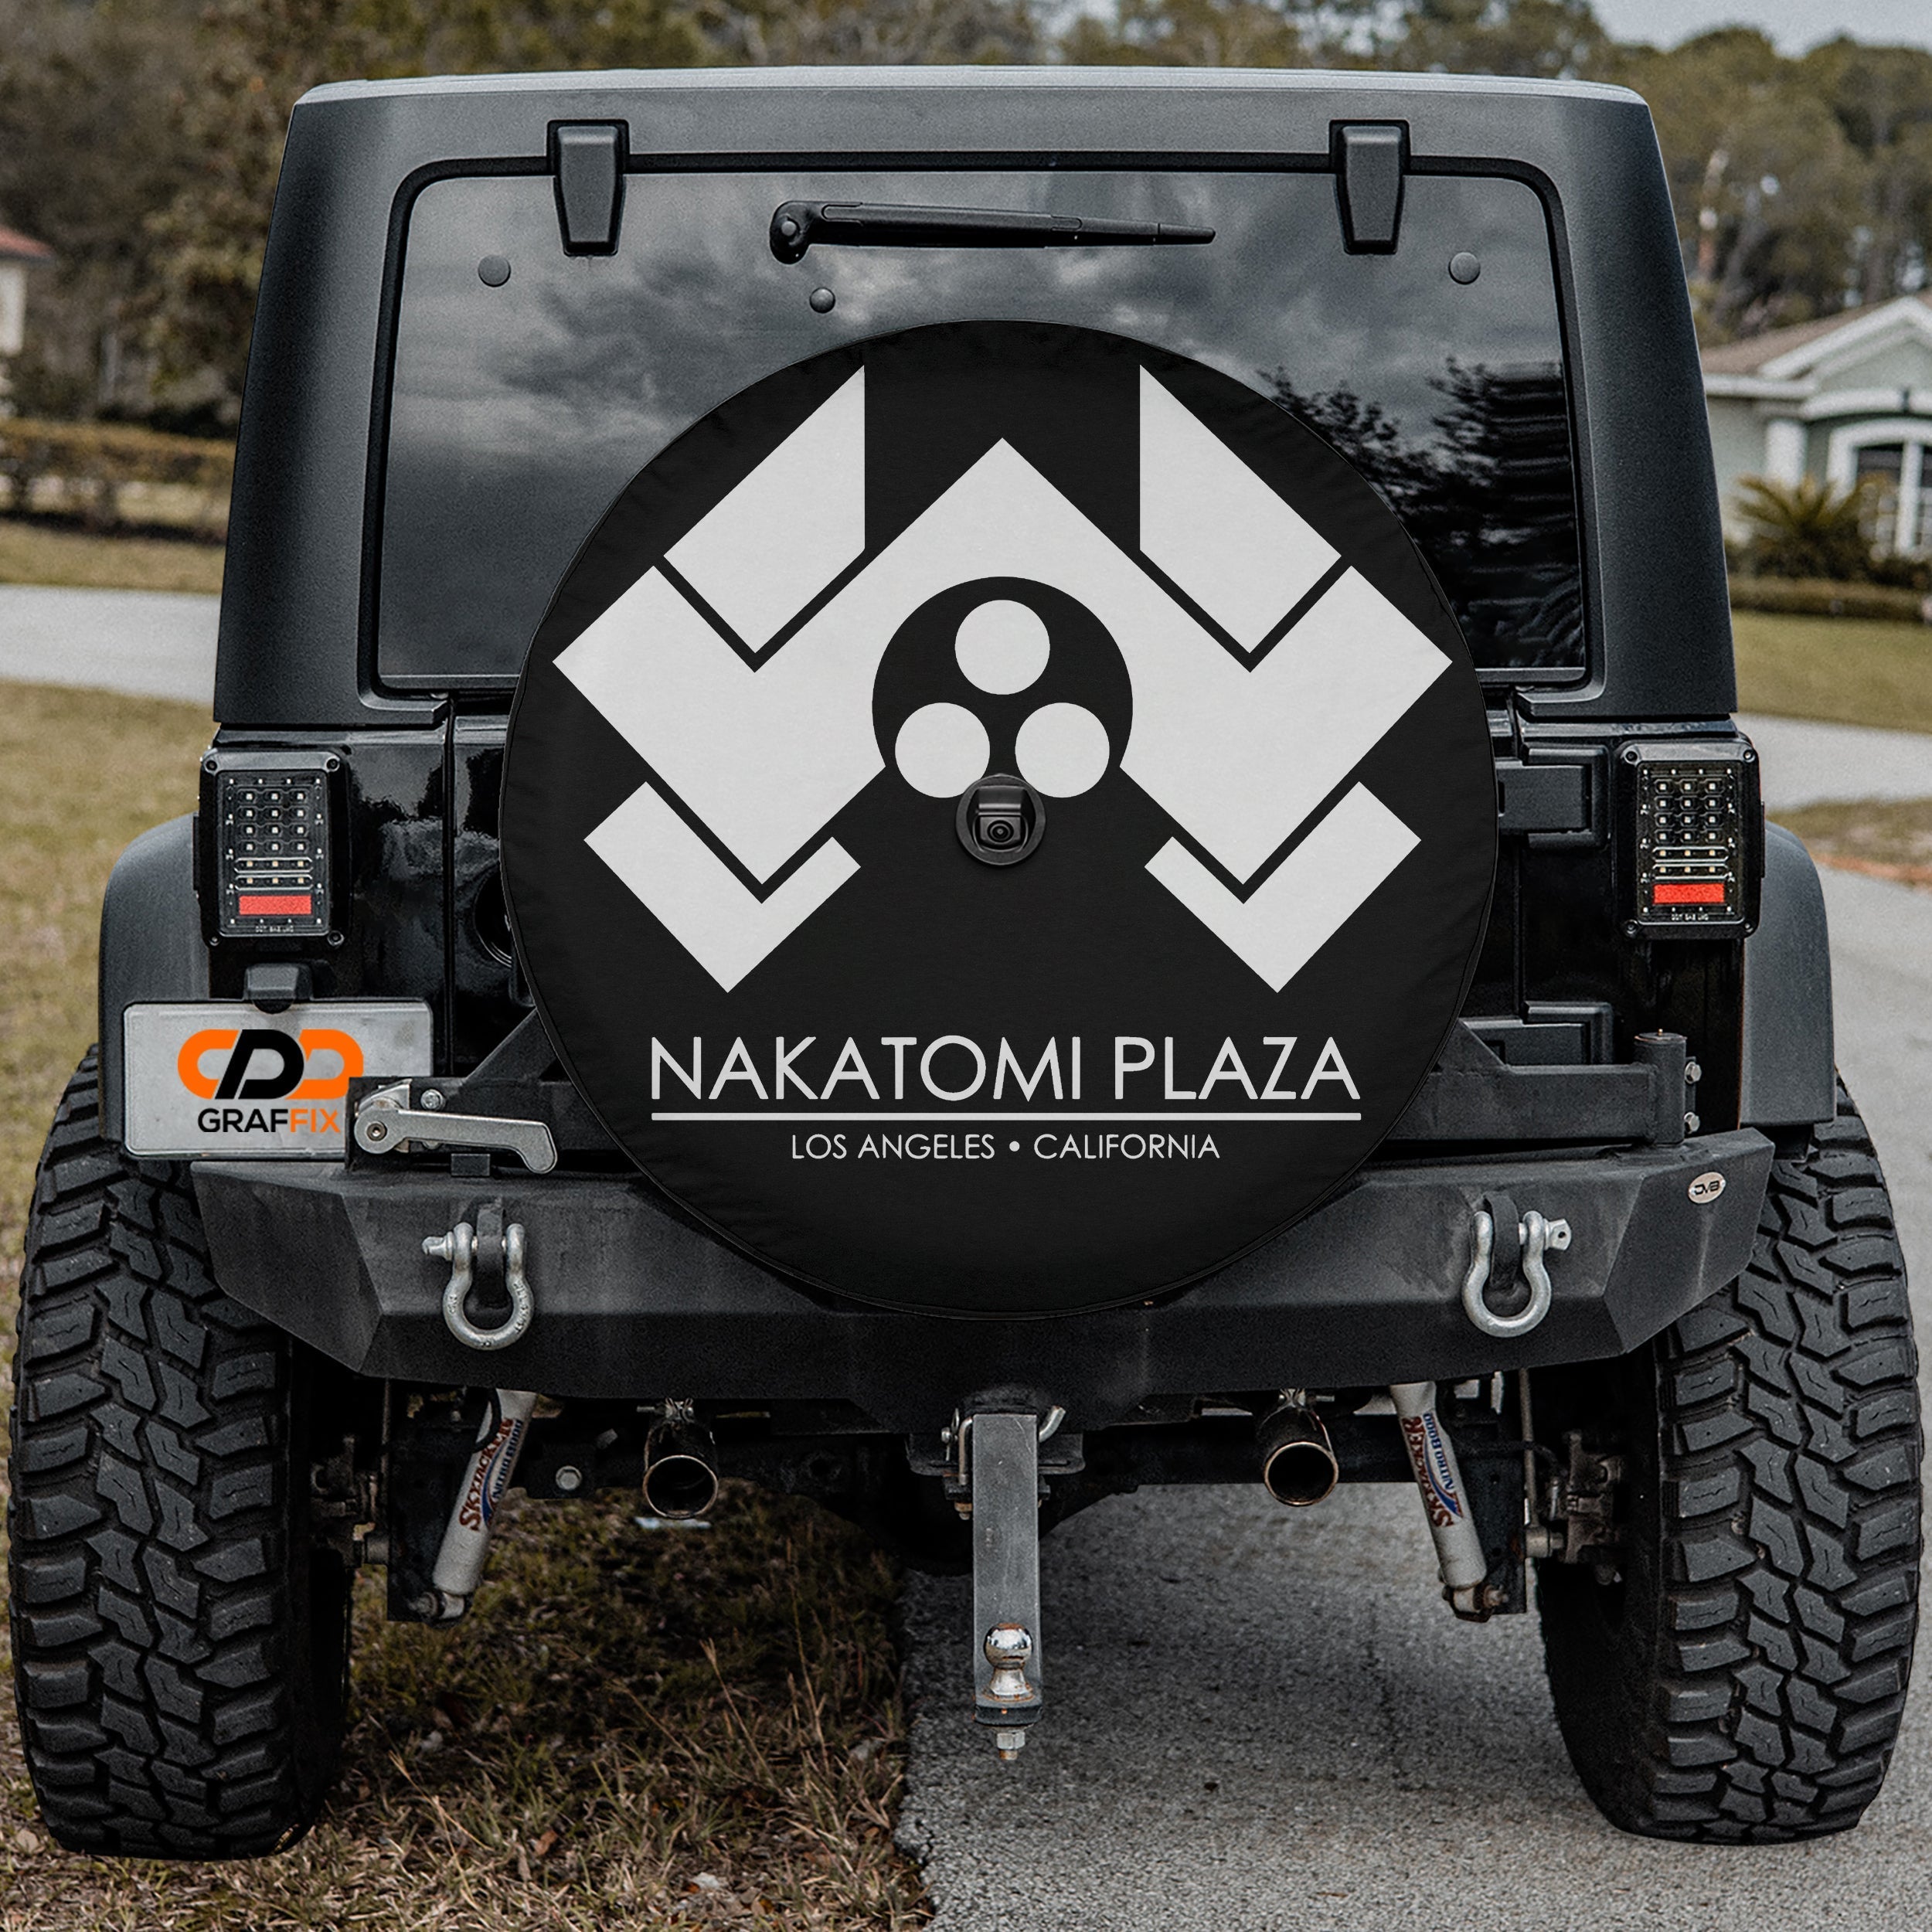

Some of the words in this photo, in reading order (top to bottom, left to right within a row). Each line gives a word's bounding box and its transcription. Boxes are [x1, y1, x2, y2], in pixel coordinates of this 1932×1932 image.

[651, 1036, 1081, 1101] NAKATOMI
[1114, 1036, 1361, 1100] PLAZA
[198, 1108, 341, 1133] GRAFFIX
[792, 1134, 847, 1159] LOS
[857, 1133, 995, 1160] ANGELES
[1033, 1133, 1220, 1160] CALIFORNIA
[1422, 1412, 1442, 1449] 8000
[1401, 1415, 1454, 1528] SKYJACKER
[1434, 1451, 1454, 1490] NITRO
